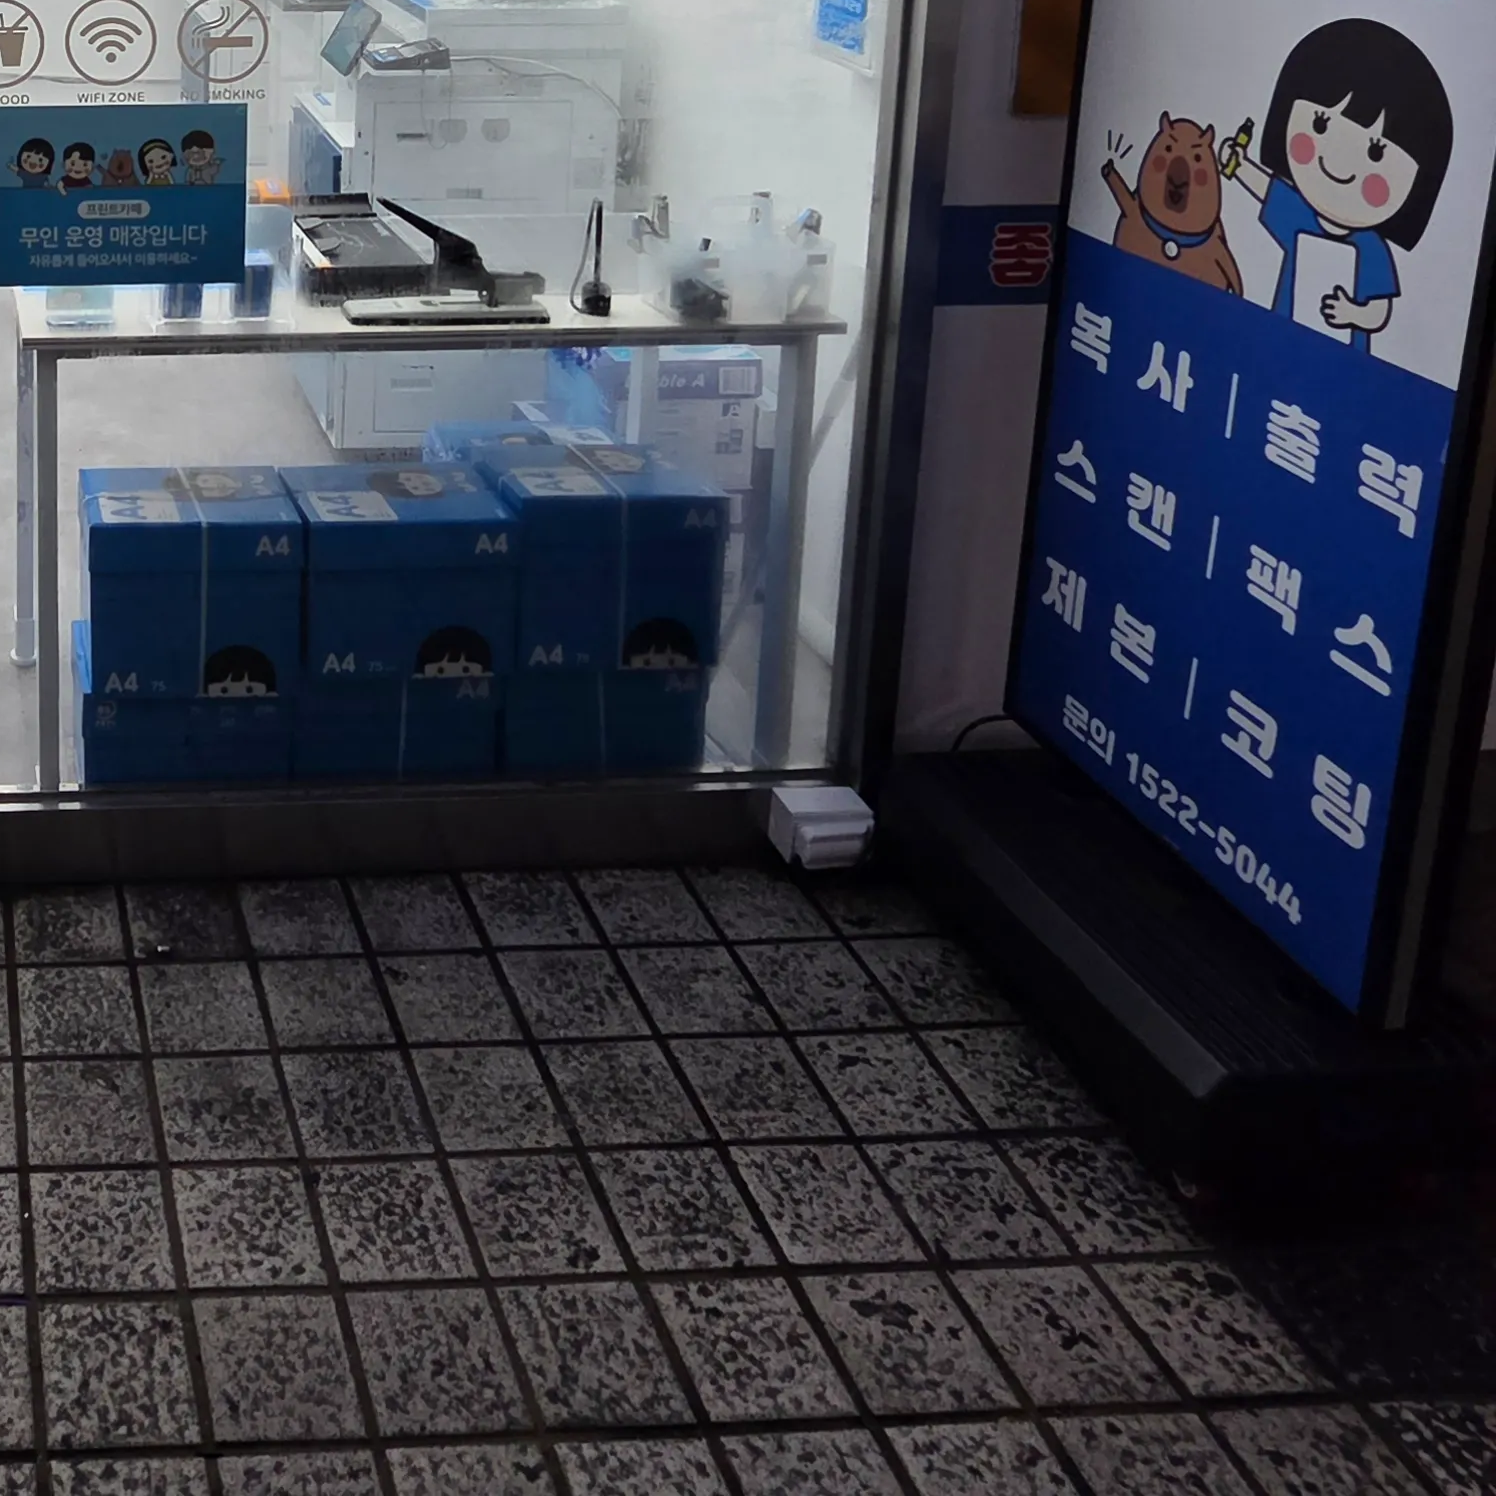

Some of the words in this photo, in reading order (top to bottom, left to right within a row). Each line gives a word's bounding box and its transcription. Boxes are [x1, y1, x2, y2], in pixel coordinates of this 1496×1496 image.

[77, 93, 105, 104] WIFI
[108, 91, 145, 103] ZONE
[206, 89, 266, 101] MOKING
[85, 203, 142, 216] 프린트카페
[19, 226, 58, 248] 무인
[65, 225, 103, 248] 운영
[109, 224, 208, 247] 매장입니다
[1070, 302, 1194, 413] 복사
[1264, 399, 1424, 538] 출력
[255, 535, 291, 557] A4
[475, 533, 508, 555] A4
[1055, 440, 1177, 551] 스캔
[1246, 545, 1393, 696] 팩스
[323, 652, 357, 674] A4
[528, 644, 564, 666] A4
[104, 672, 140, 694] A4
[1042, 557, 1156, 683] 제본
[1221, 690, 1371, 849] 코팅
[1063, 695, 1116, 766] 문의
[1127, 752, 1302, 925] 1522-5044
